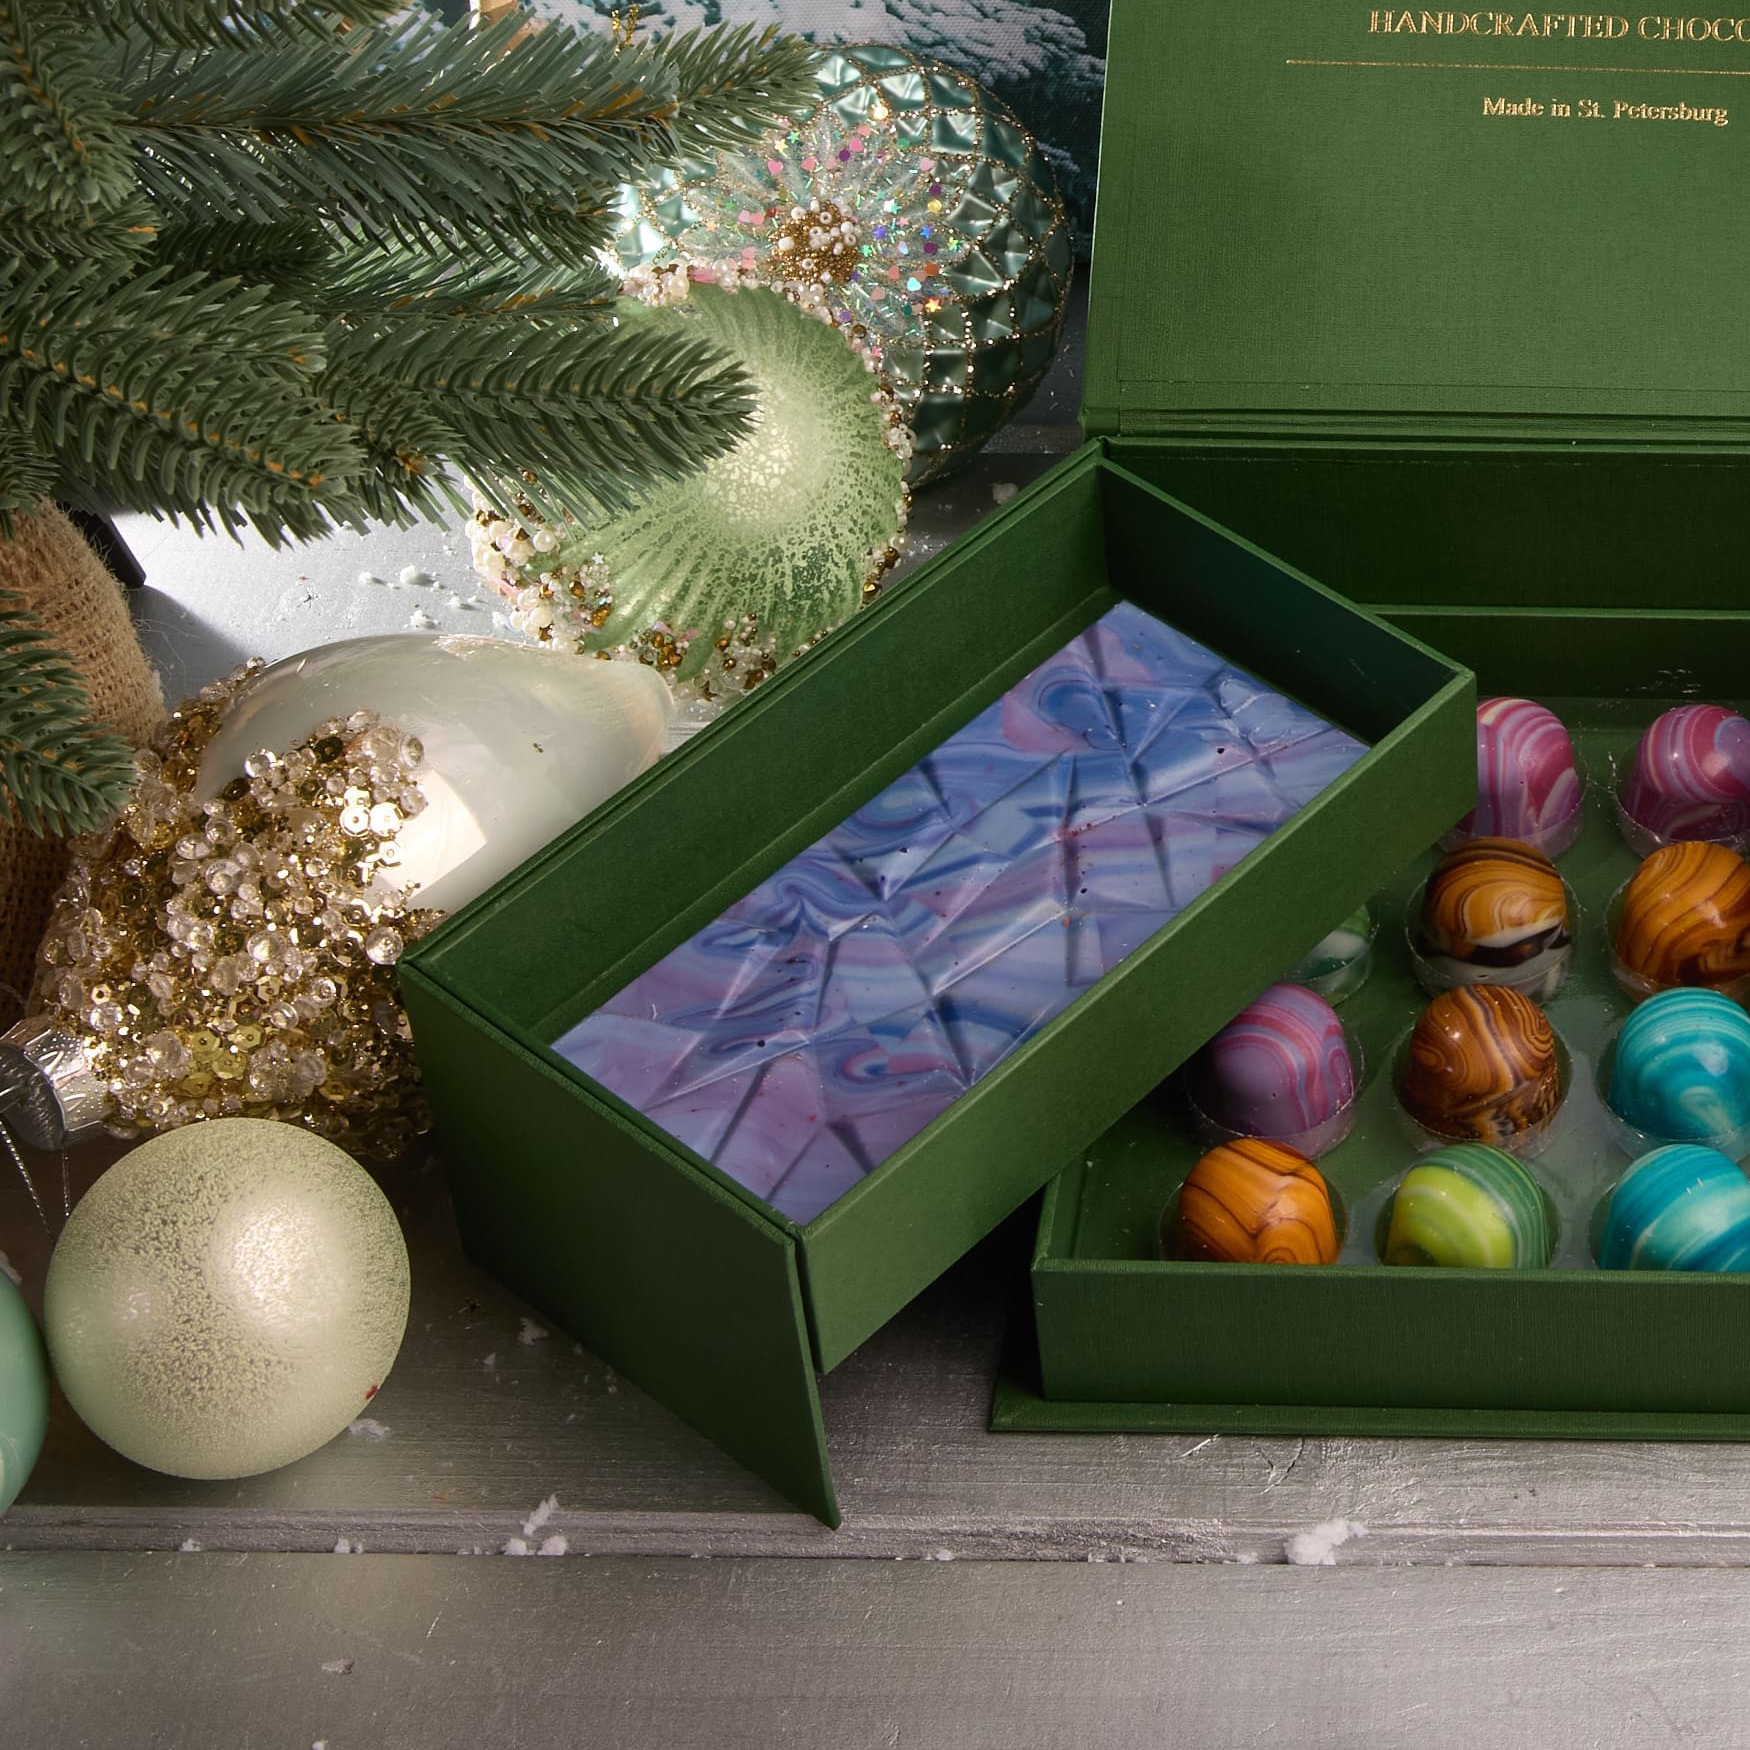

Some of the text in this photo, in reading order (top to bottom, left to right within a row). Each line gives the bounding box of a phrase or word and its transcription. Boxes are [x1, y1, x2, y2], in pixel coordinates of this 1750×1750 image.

[1367, 10, 1629, 40] HANDCRAFTED
[1481, 96, 1729, 126] Made in St. Petersburg
